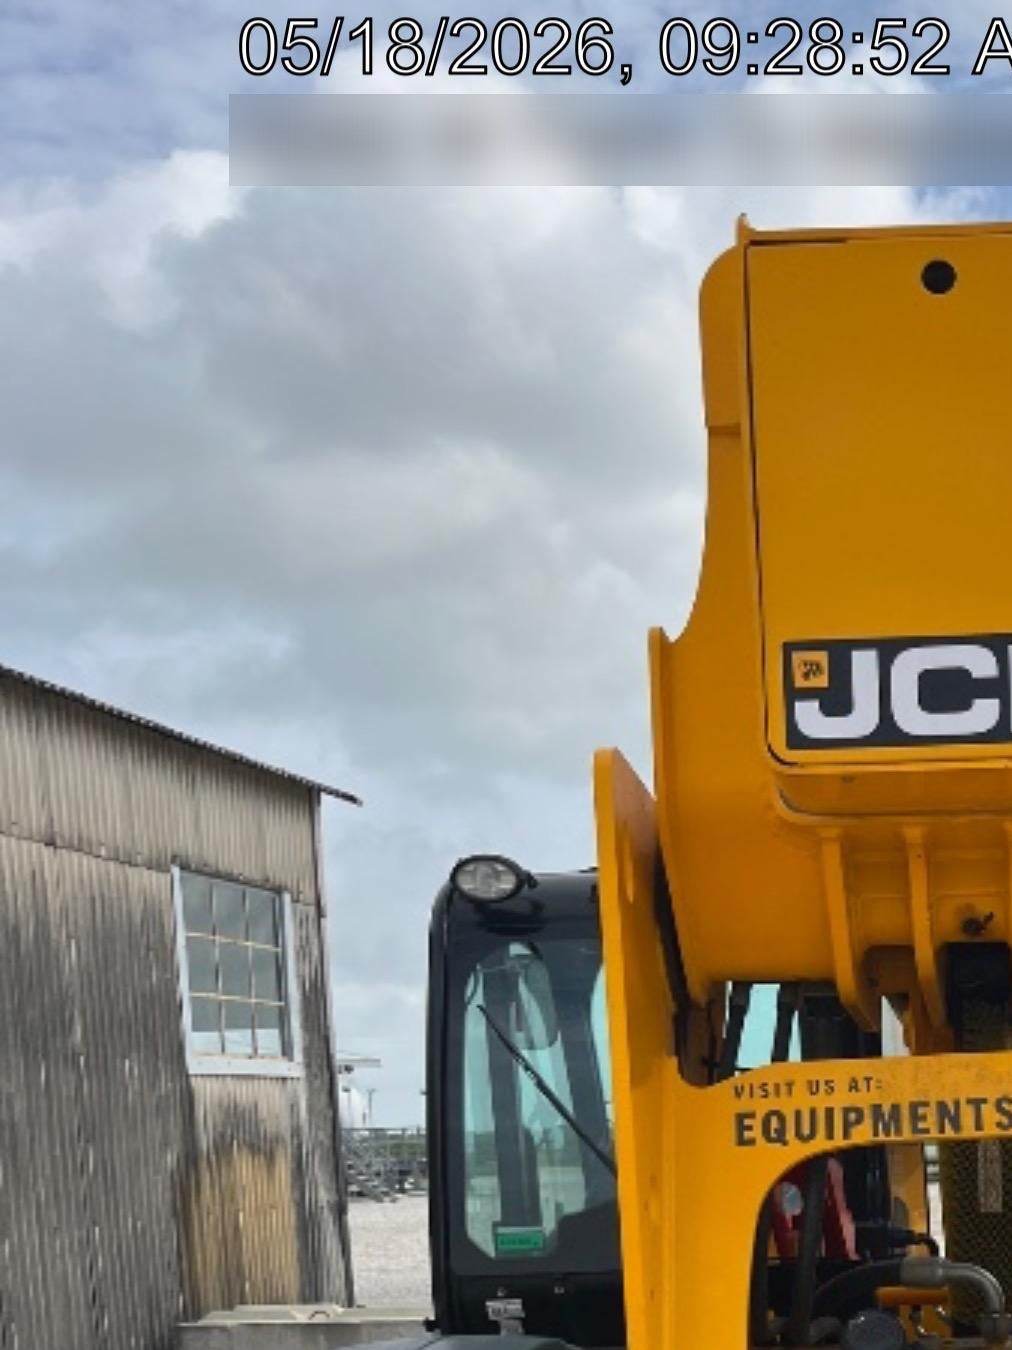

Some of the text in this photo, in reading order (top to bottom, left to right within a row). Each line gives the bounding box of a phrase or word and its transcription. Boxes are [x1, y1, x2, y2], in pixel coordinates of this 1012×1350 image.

[734, 1076, 882, 1099] VISIT US AT:
